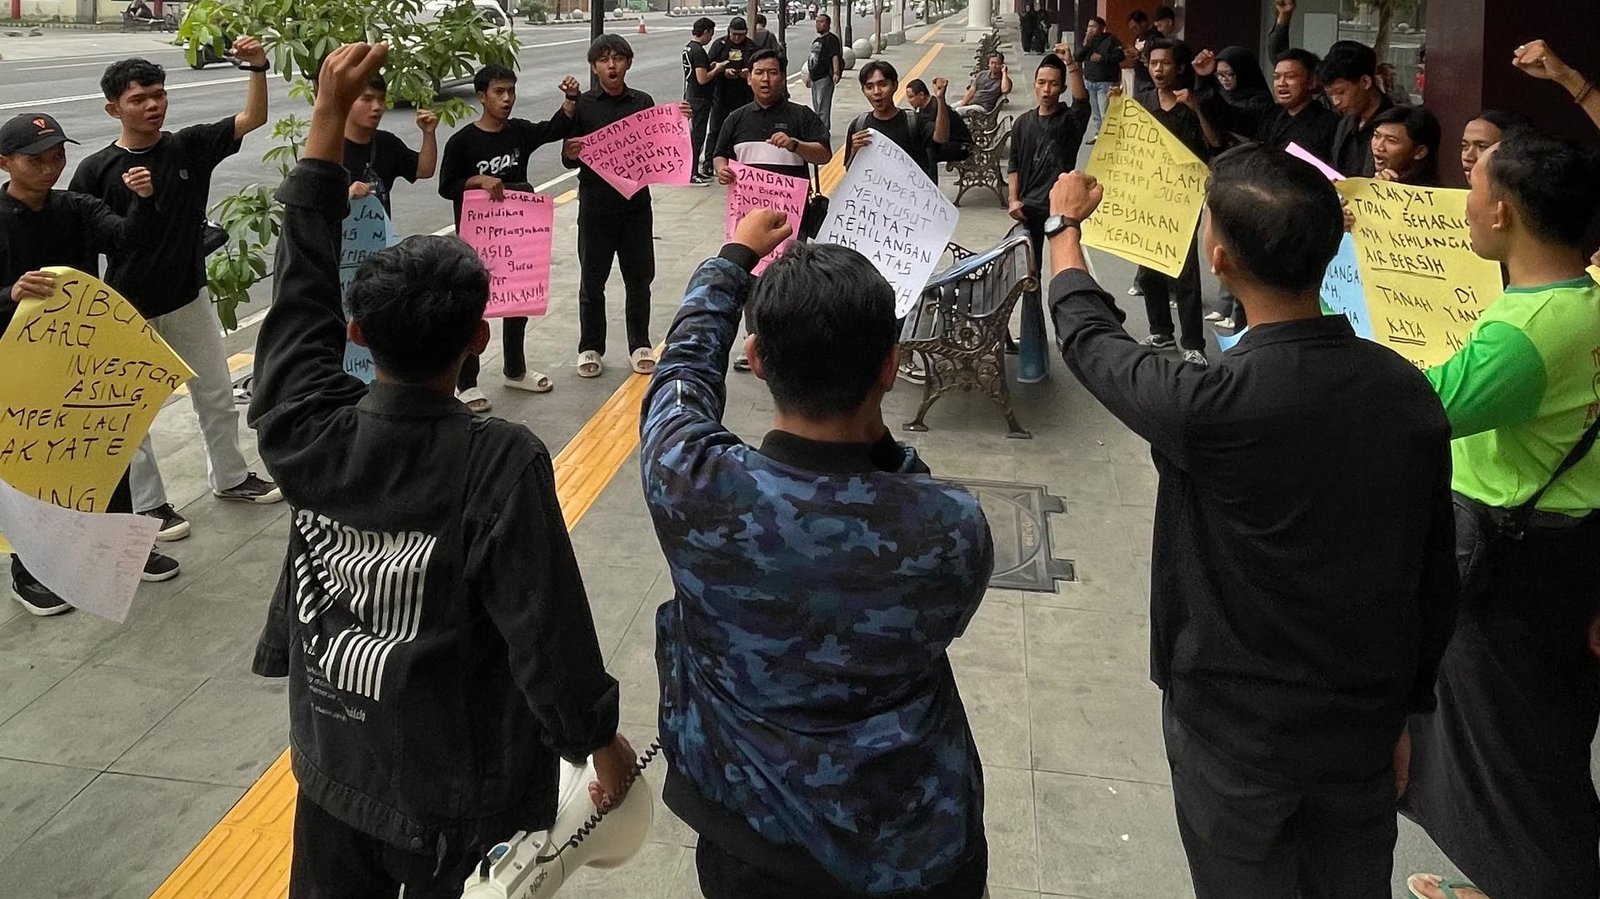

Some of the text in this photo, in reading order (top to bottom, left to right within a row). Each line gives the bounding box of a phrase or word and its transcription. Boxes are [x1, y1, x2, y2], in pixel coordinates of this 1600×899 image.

[581, 106, 673, 149] NEGARA BUTUH
[581, 131, 642, 166] GENERASI
[1097, 151, 1143, 170] URUSAN
[1115, 139, 1156, 159] BUKAN
[739, 168, 796, 189] JANGAN
[1107, 169, 1191, 205] TETAPI JUGA
[488, 193, 545, 204] AGGARAN
[852, 184, 933, 230] MENYUSUT
[864, 168, 949, 222] SUMBER AIR
[1354, 198, 1392, 220] TIDAK
[1369, 183, 1434, 211] RAKYAT
[845, 199, 915, 238] RAKYAT
[834, 214, 932, 264] KEHILANGAN
[872, 250, 912, 276] ATAS
[1365, 247, 1446, 275] AIR BERSIH
[1376, 285, 1434, 312] TANAH
[1386, 316, 1426, 338] KAYA
[66, 354, 182, 391] INVESTOR
